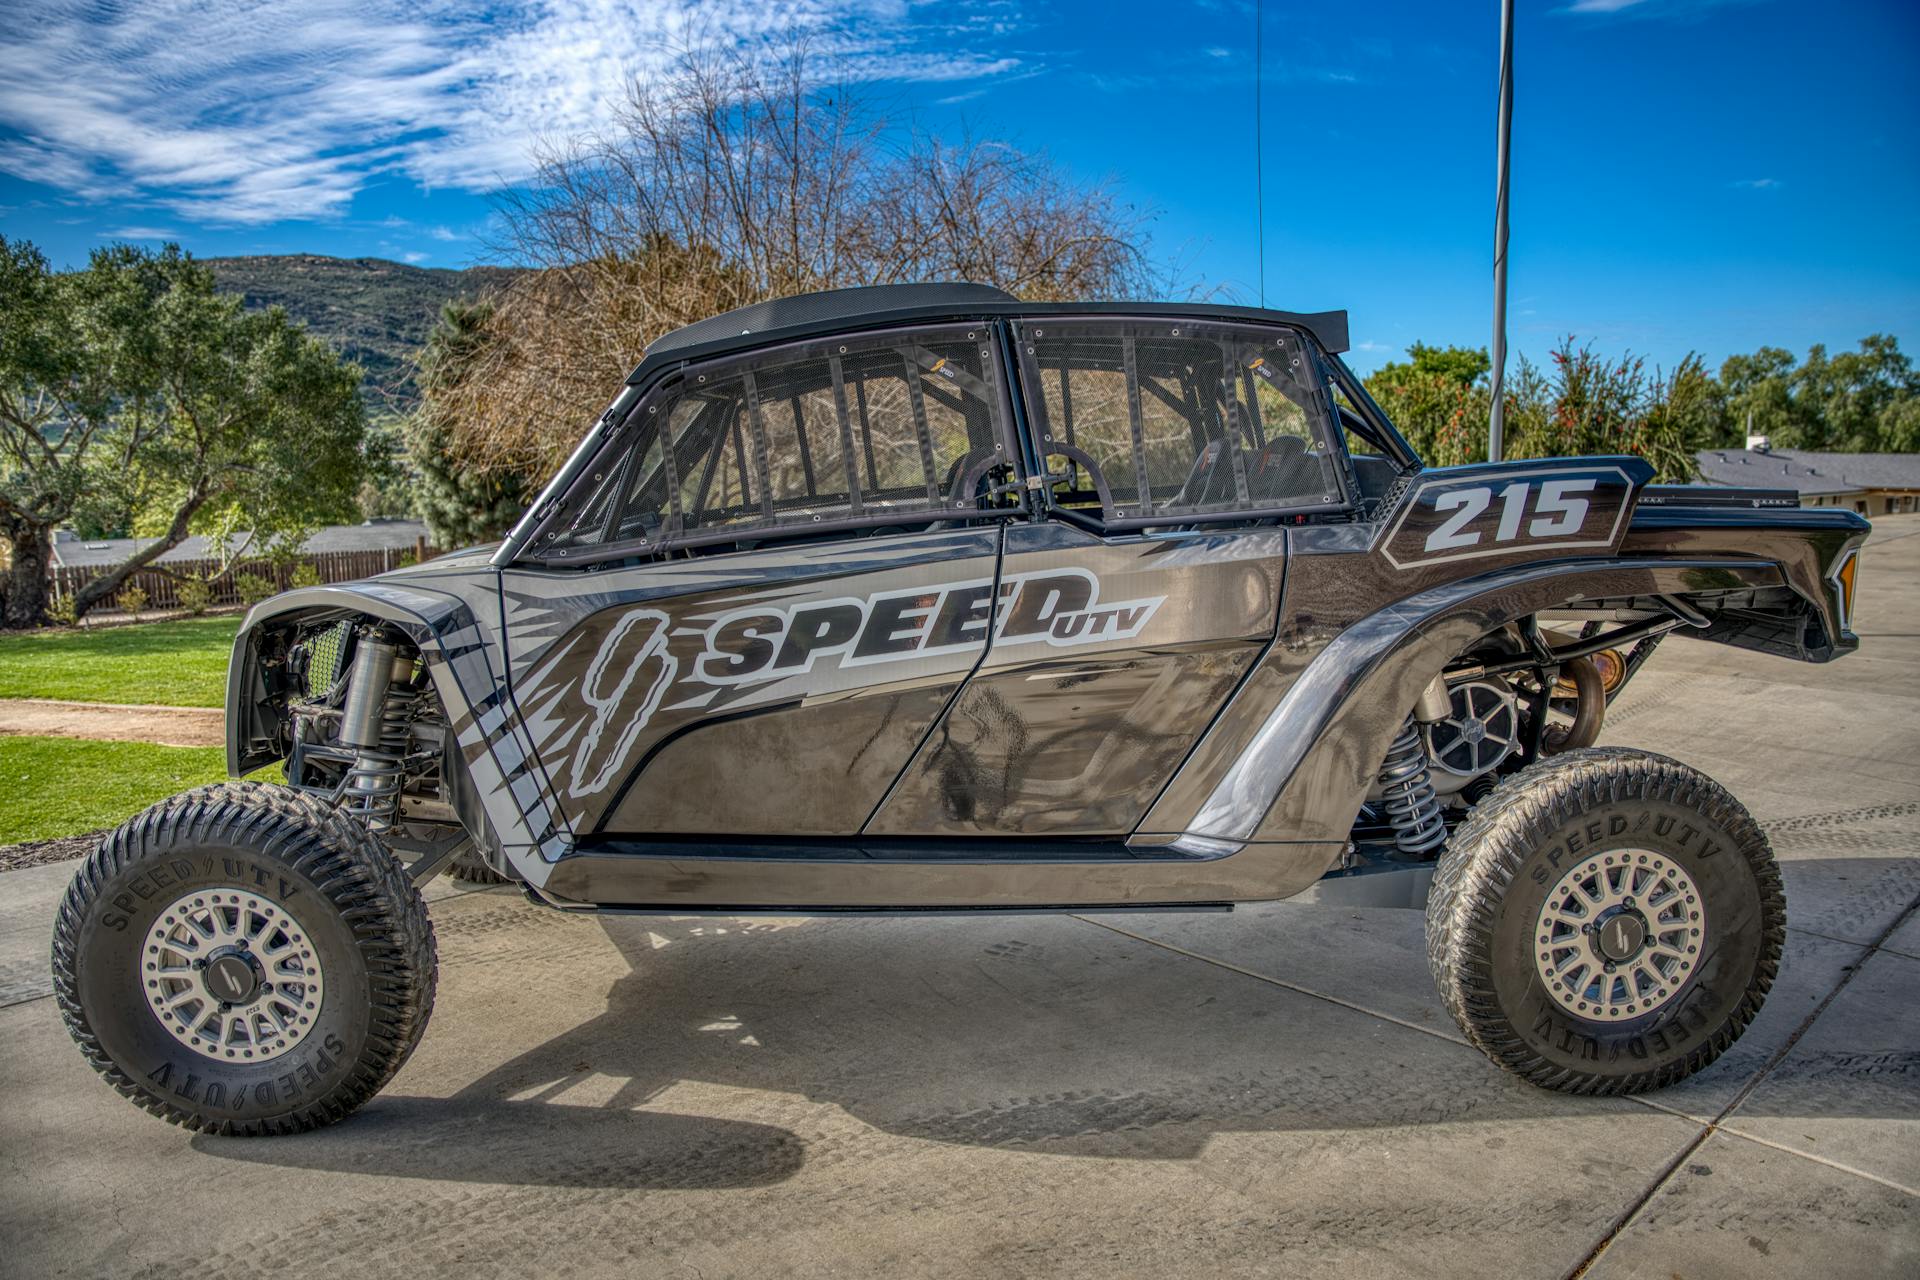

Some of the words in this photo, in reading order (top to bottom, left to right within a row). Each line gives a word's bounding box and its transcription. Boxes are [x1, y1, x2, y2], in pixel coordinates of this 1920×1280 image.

[1423, 478, 1598, 552] 215
[700, 571, 1096, 681] SPEED
[1050, 603, 1152, 639] UTV
[1530, 814, 1632, 886] SPEED
[1656, 814, 1722, 861] UTV
[102, 858, 197, 932] SPEED
[222, 857, 299, 901] UTV
[148, 1062, 232, 1109] UTV
[254, 1033, 346, 1111] SPEED
